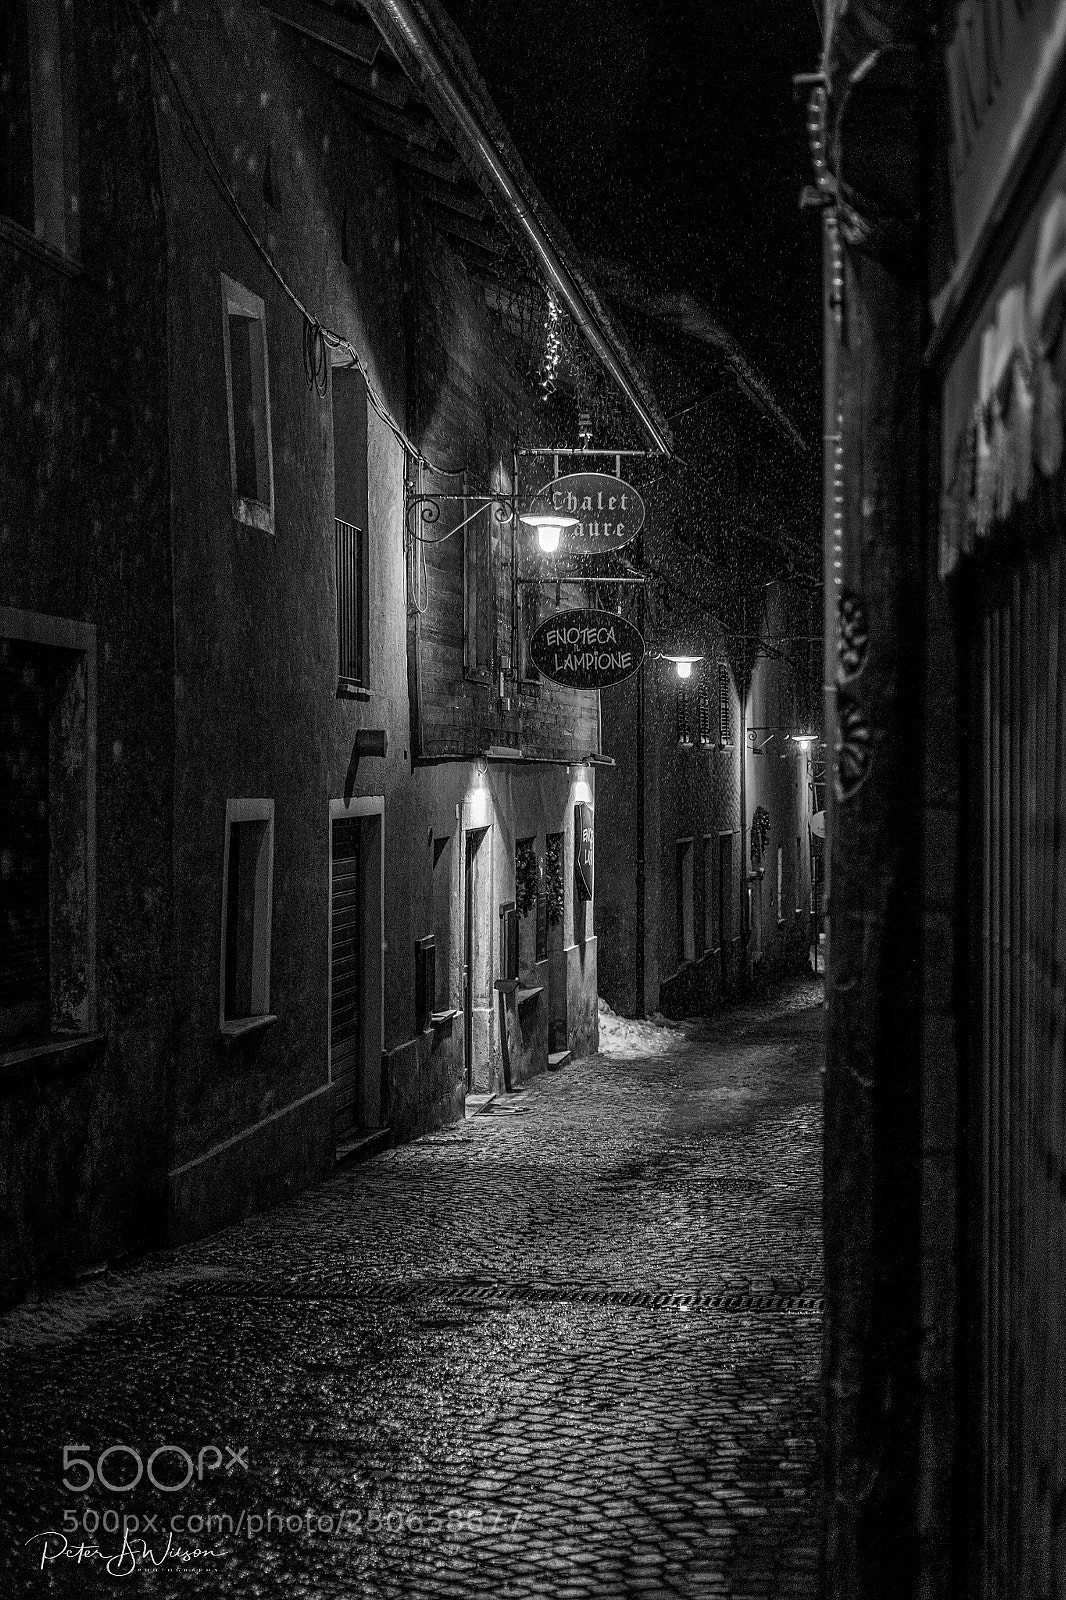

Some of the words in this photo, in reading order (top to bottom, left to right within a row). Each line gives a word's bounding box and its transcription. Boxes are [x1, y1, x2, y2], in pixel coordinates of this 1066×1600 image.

[552, 491, 628, 513] Chalet
[571, 520, 625, 537] aure
[546, 626, 616, 646] ENOTECA
[554, 651, 632, 671] LAMPIONE
